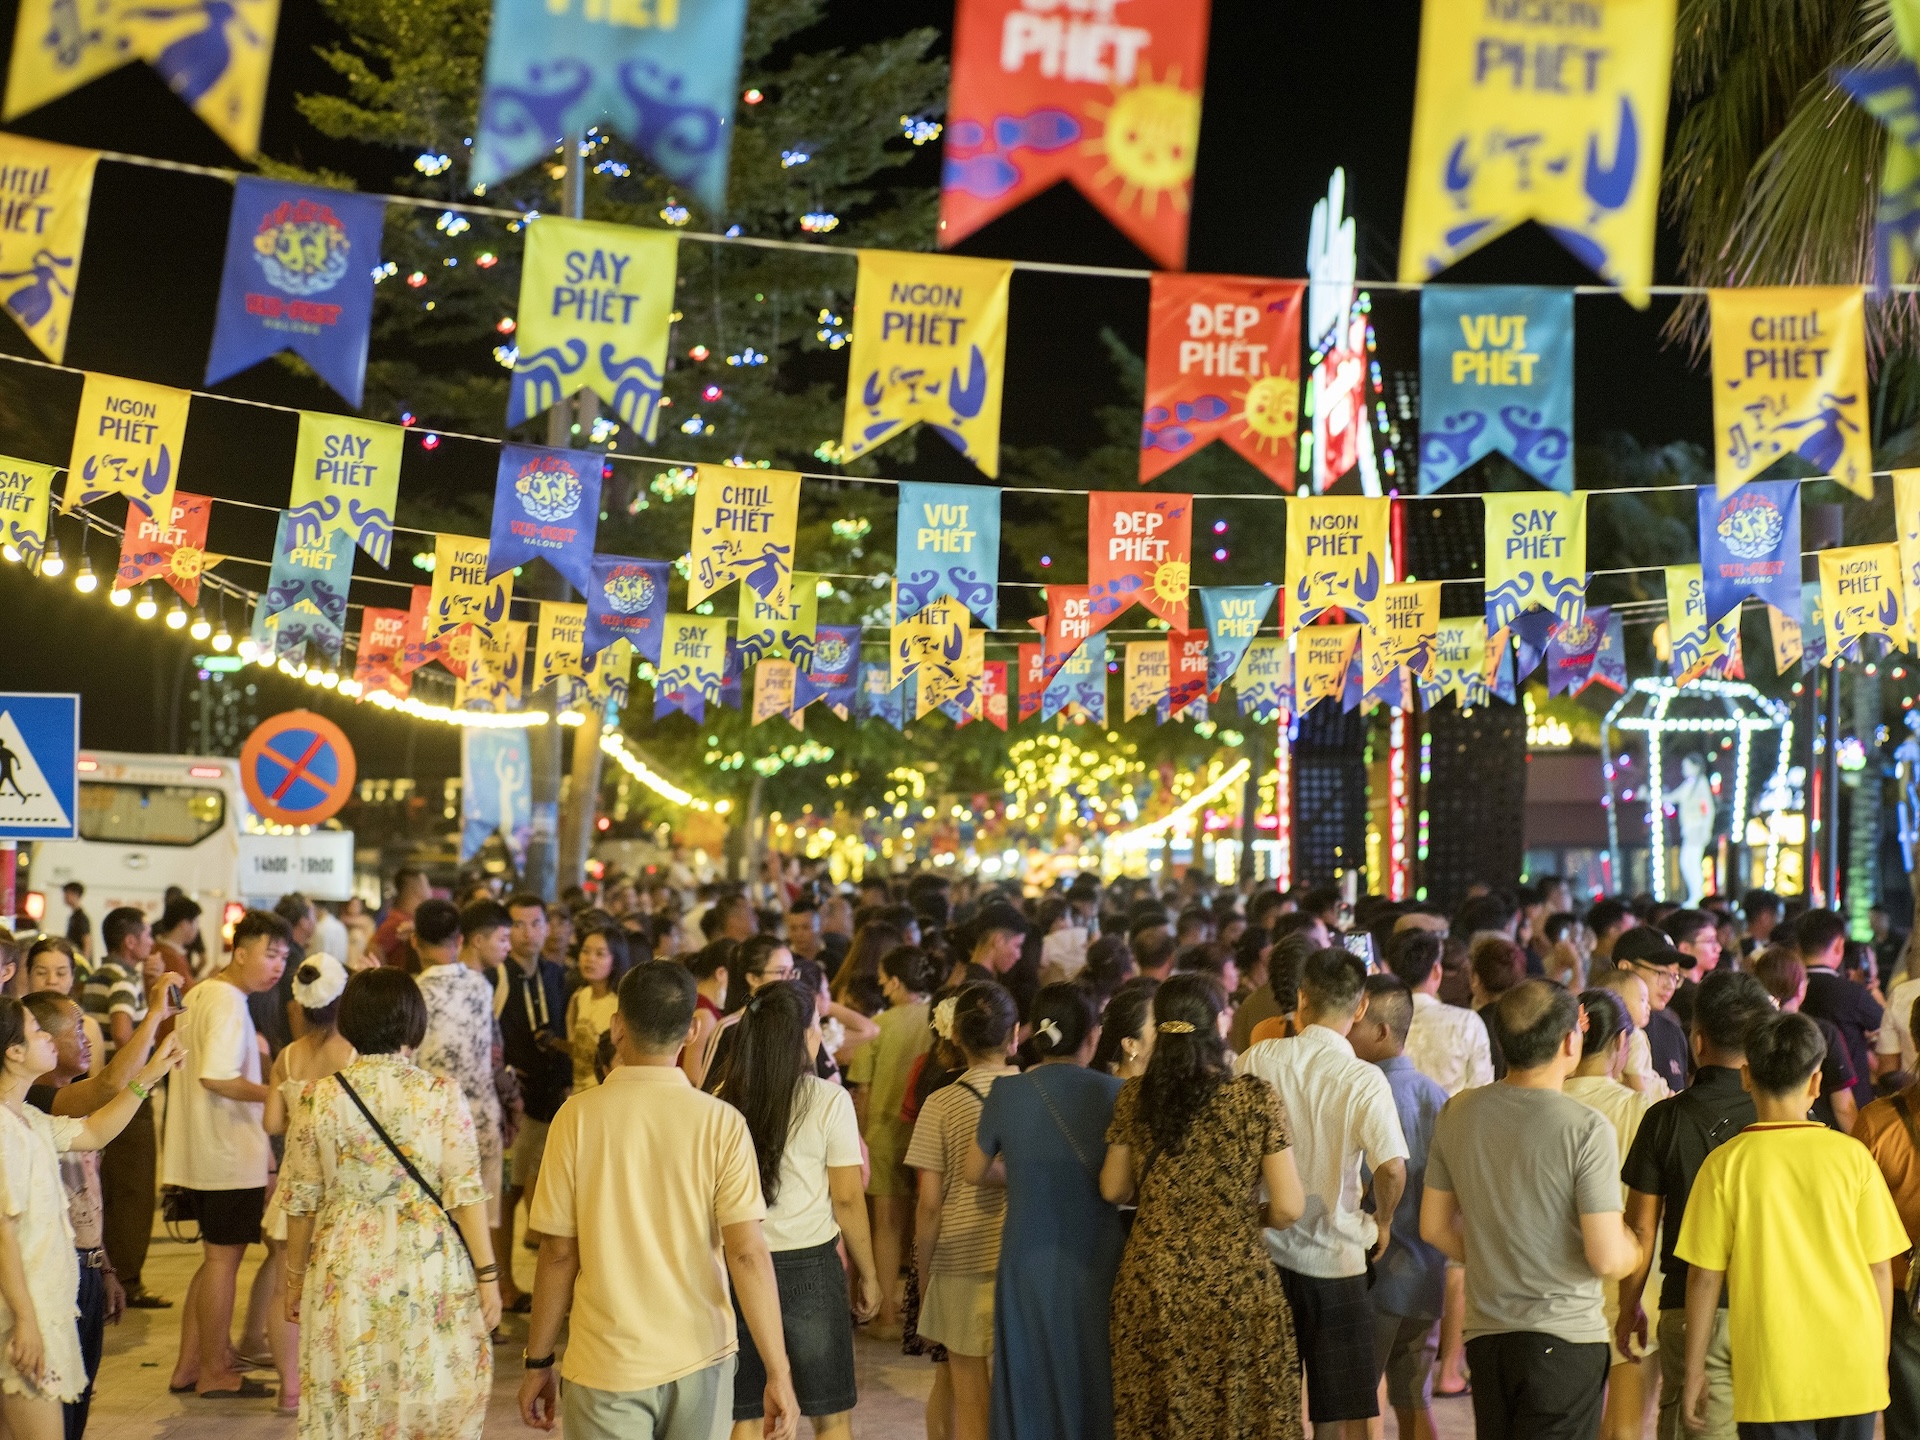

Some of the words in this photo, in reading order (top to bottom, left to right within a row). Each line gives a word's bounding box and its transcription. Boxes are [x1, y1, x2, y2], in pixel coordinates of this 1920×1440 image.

[565, 249, 630, 285] SAY
[889, 282, 963, 308] NGON
[1459, 314, 1528, 351] VUI
[1750, 310, 1827, 343] CHILL
[105, 396, 157, 419] NGON
[98, 415, 159, 445] PHẾT
[323, 433, 372, 460] SAY
[315, 458, 378, 487] PHẾT
[722, 485, 774, 507] CHILL
[715, 507, 775, 533] PHẾT
[923, 502, 970, 528] VUI
[1112, 511, 1164, 536] ĐẸP
[1309, 514, 1359, 530] NGON
[1511, 508, 1558, 536] SAY
[917, 527, 977, 553] PHẾT
[1108, 535, 1170, 562] PHẾT
[1306, 531, 1363, 556] PHẾT
[1506, 532, 1567, 560] PHẾT
[1840, 560, 1878, 575] NGON
[1838, 573, 1882, 595] PHẾT
[1220, 599, 1257, 619] VUI
[678, 626, 708, 641] SAY
[1437, 630, 1464, 646] SAY
[1250, 647, 1276, 662] SAY
